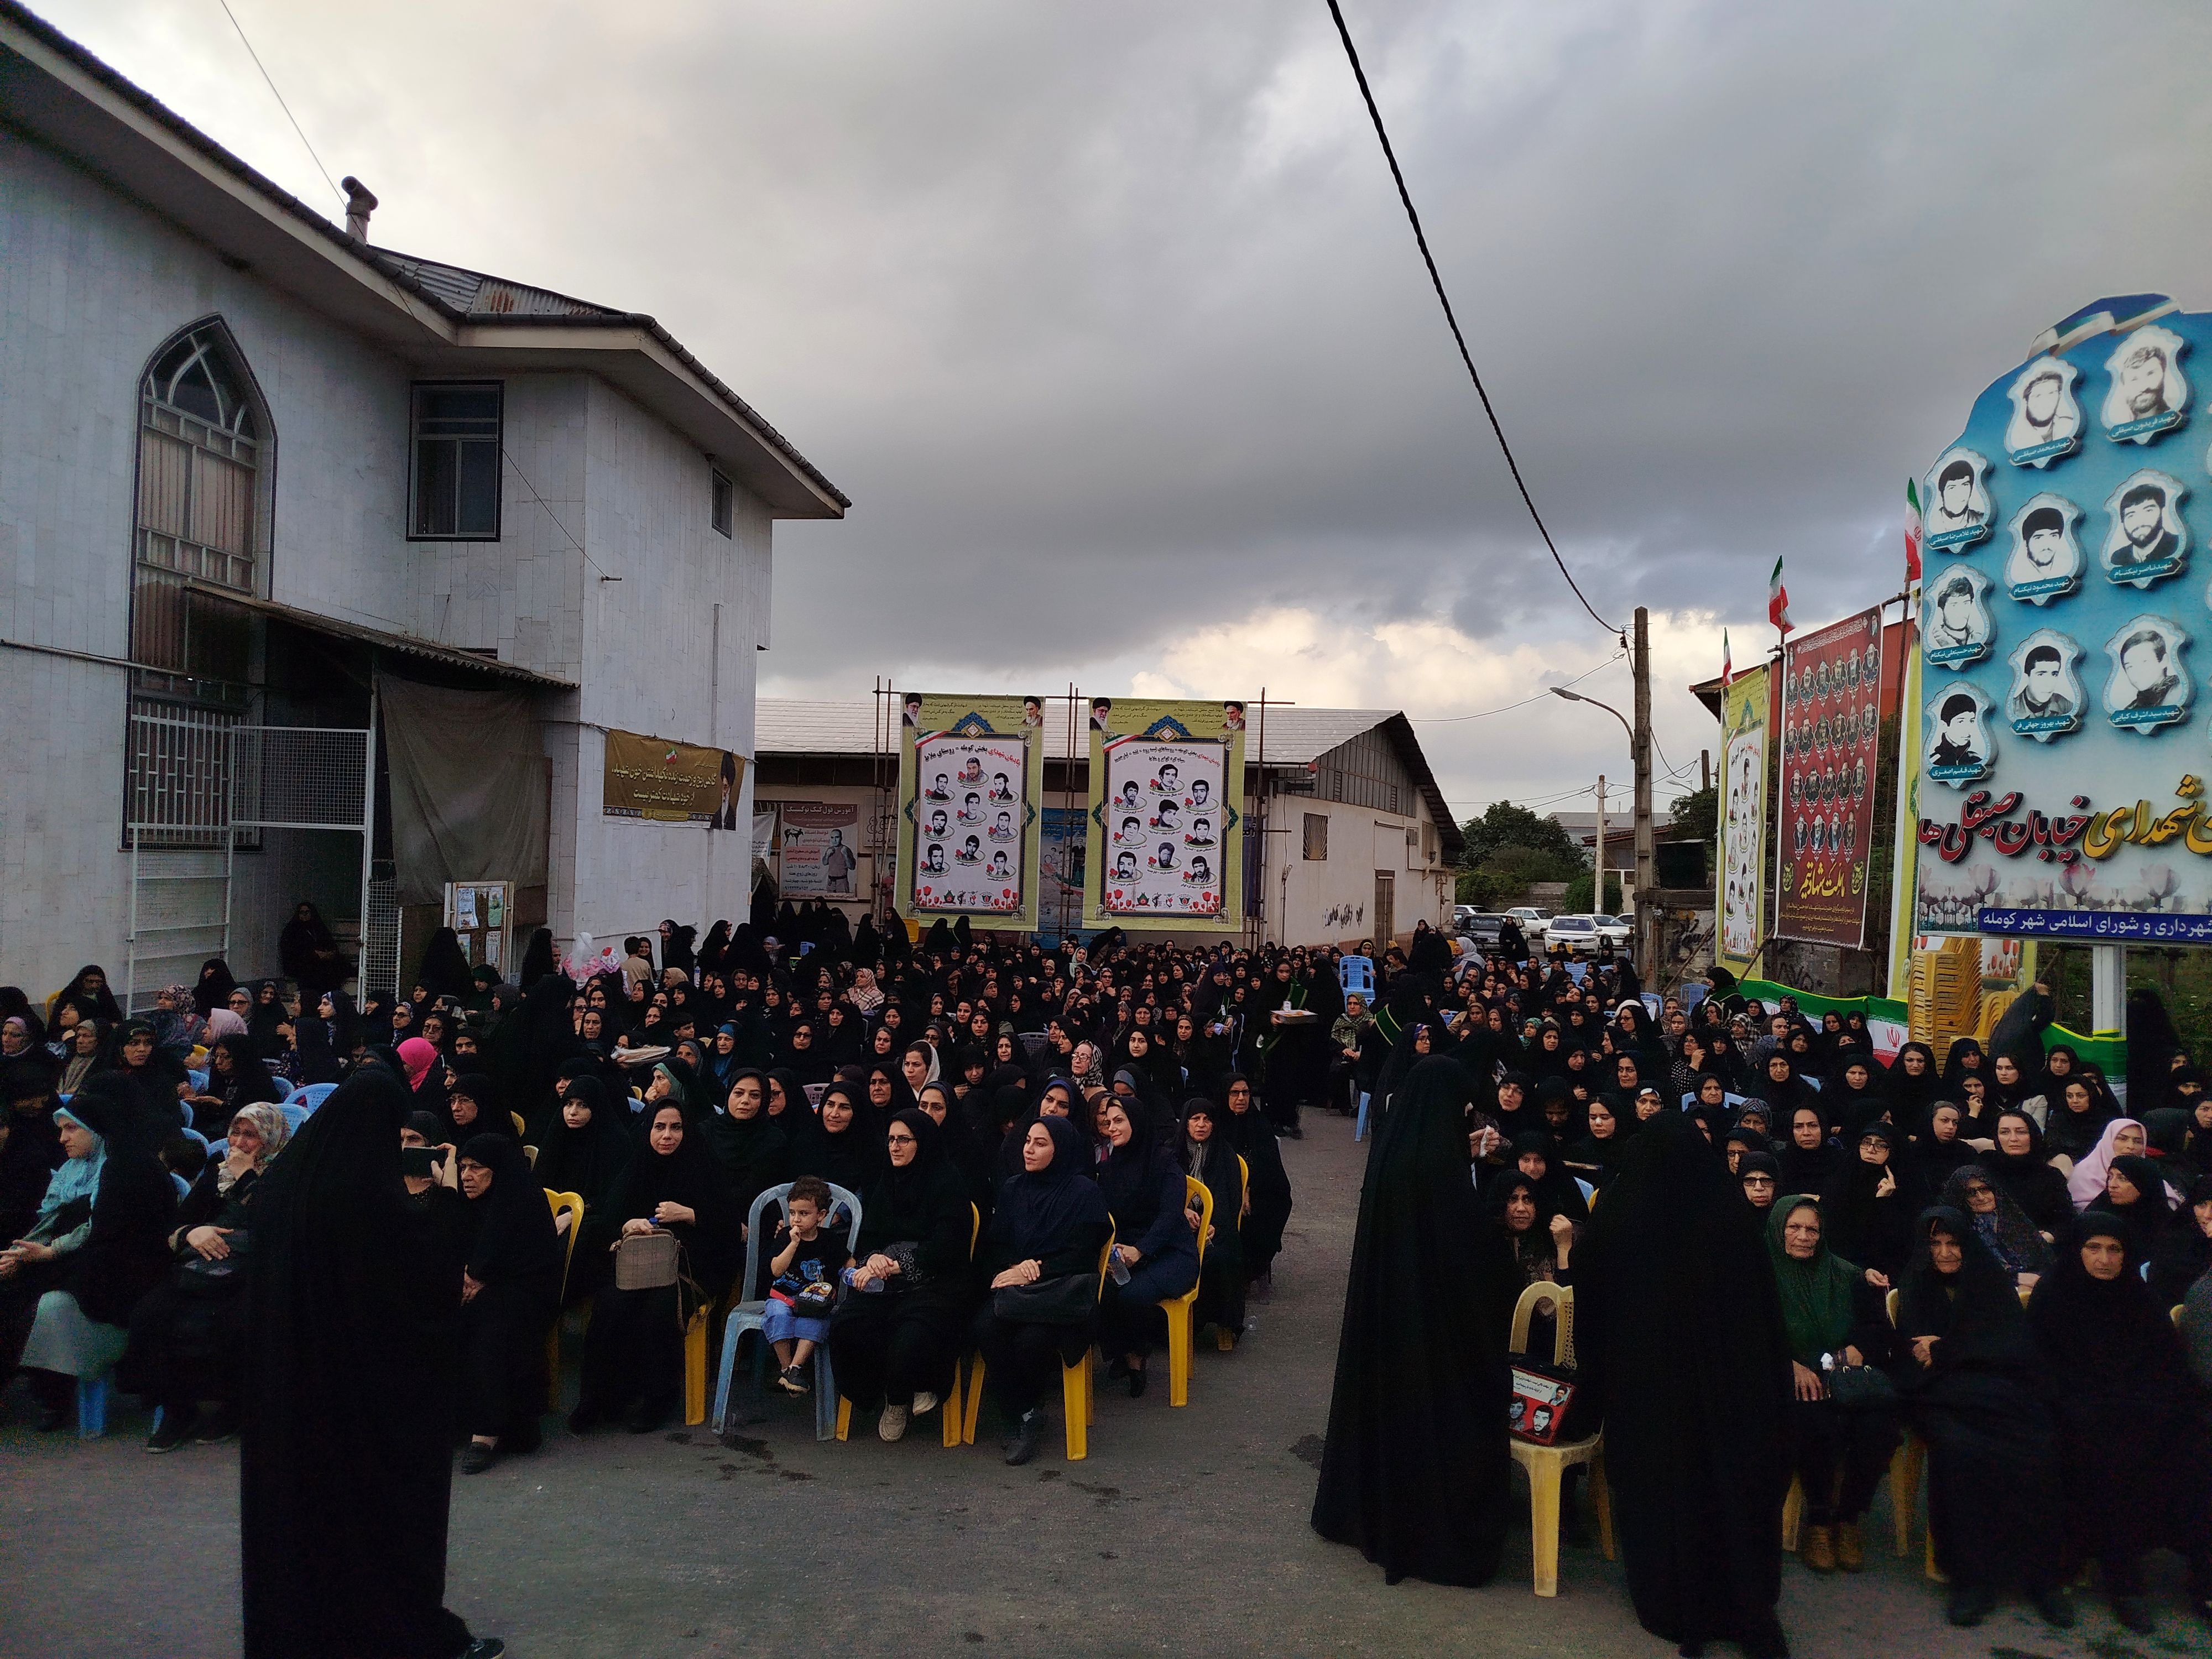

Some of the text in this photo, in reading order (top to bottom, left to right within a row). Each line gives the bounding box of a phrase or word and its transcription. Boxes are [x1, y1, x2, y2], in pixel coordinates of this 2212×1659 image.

[2112, 425, 2134, 437] صیقلی
[2014, 449, 2037, 461] صیقلی
[2037, 445, 2056, 454] محمد
[1929, 526, 1984, 546] شهید غلامرضا صیقلی
[2114, 561, 2173, 579] شهید ناصر نیکنام
[2013, 578, 2070, 596] شهید محمود نیکنام
[1930, 650, 1945, 661] نیکنام
[1968, 644, 1982, 654] شهید
[2131, 711, 2149, 721] اشرف
[2162, 708, 2180, 718] شهید
[2015, 722, 2023, 731] فر
[2022, 721, 2040, 730] جهانی
[2054, 718, 2070, 727] شهید
[1932, 766, 1982, 777] شهید قاسم اصغری
[2083, 773, 2199, 859] شهدای
[1917, 818, 1942, 845] ها
[1938, 790, 2017, 863] صیقلی
[1994, 795, 2089, 863] خیابان
[1983, 911, 2017, 927] کومله
[2019, 915, 2046, 930] شهر
[2049, 914, 2093, 932] اسلامی
[2096, 915, 2139, 936] شورای
[2143, 921, 2152, 934] و
